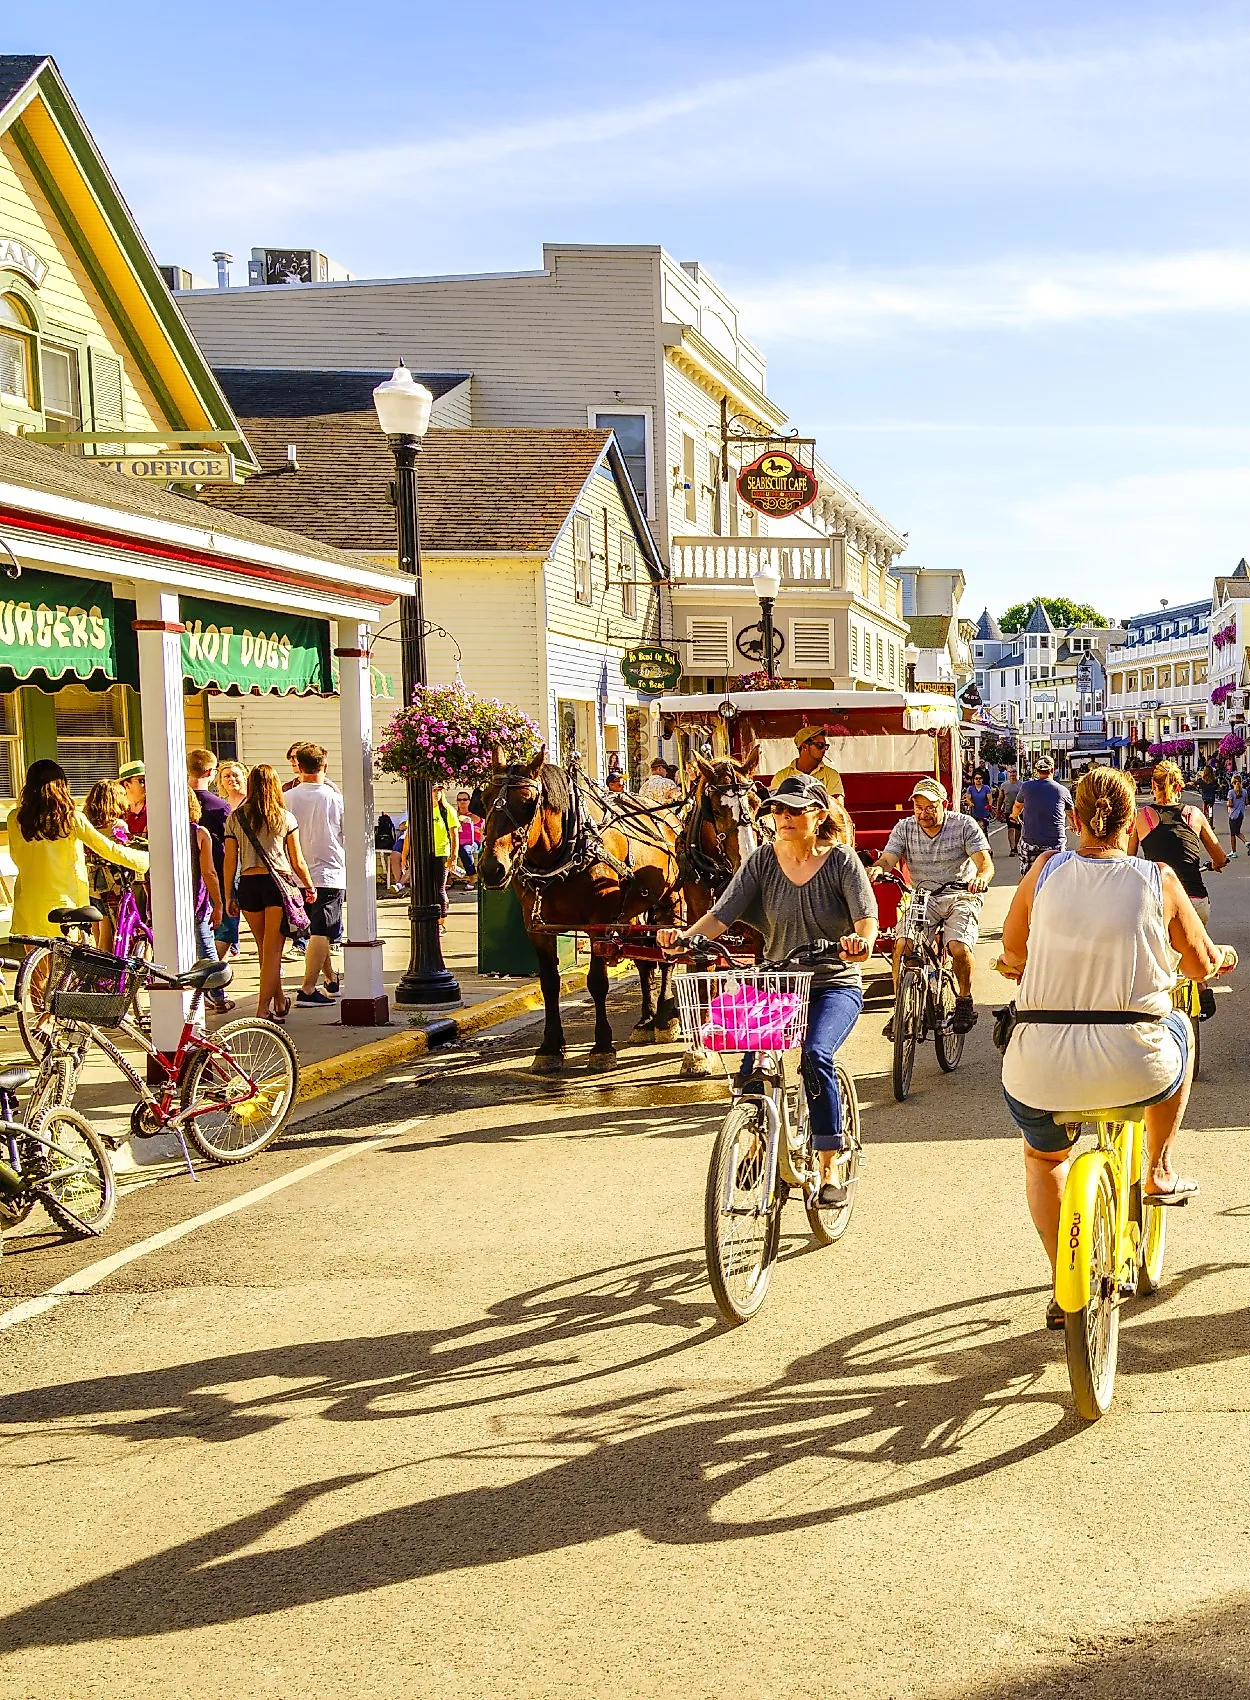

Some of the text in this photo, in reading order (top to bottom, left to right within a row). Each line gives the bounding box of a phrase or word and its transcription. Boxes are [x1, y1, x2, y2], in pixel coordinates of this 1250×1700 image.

[0, 242, 41, 278] AXI
[131, 460, 223, 477] OFFICE
[747, 476, 788, 491] SEABISCUIT
[184, 619, 294, 671] HOT DOGS
